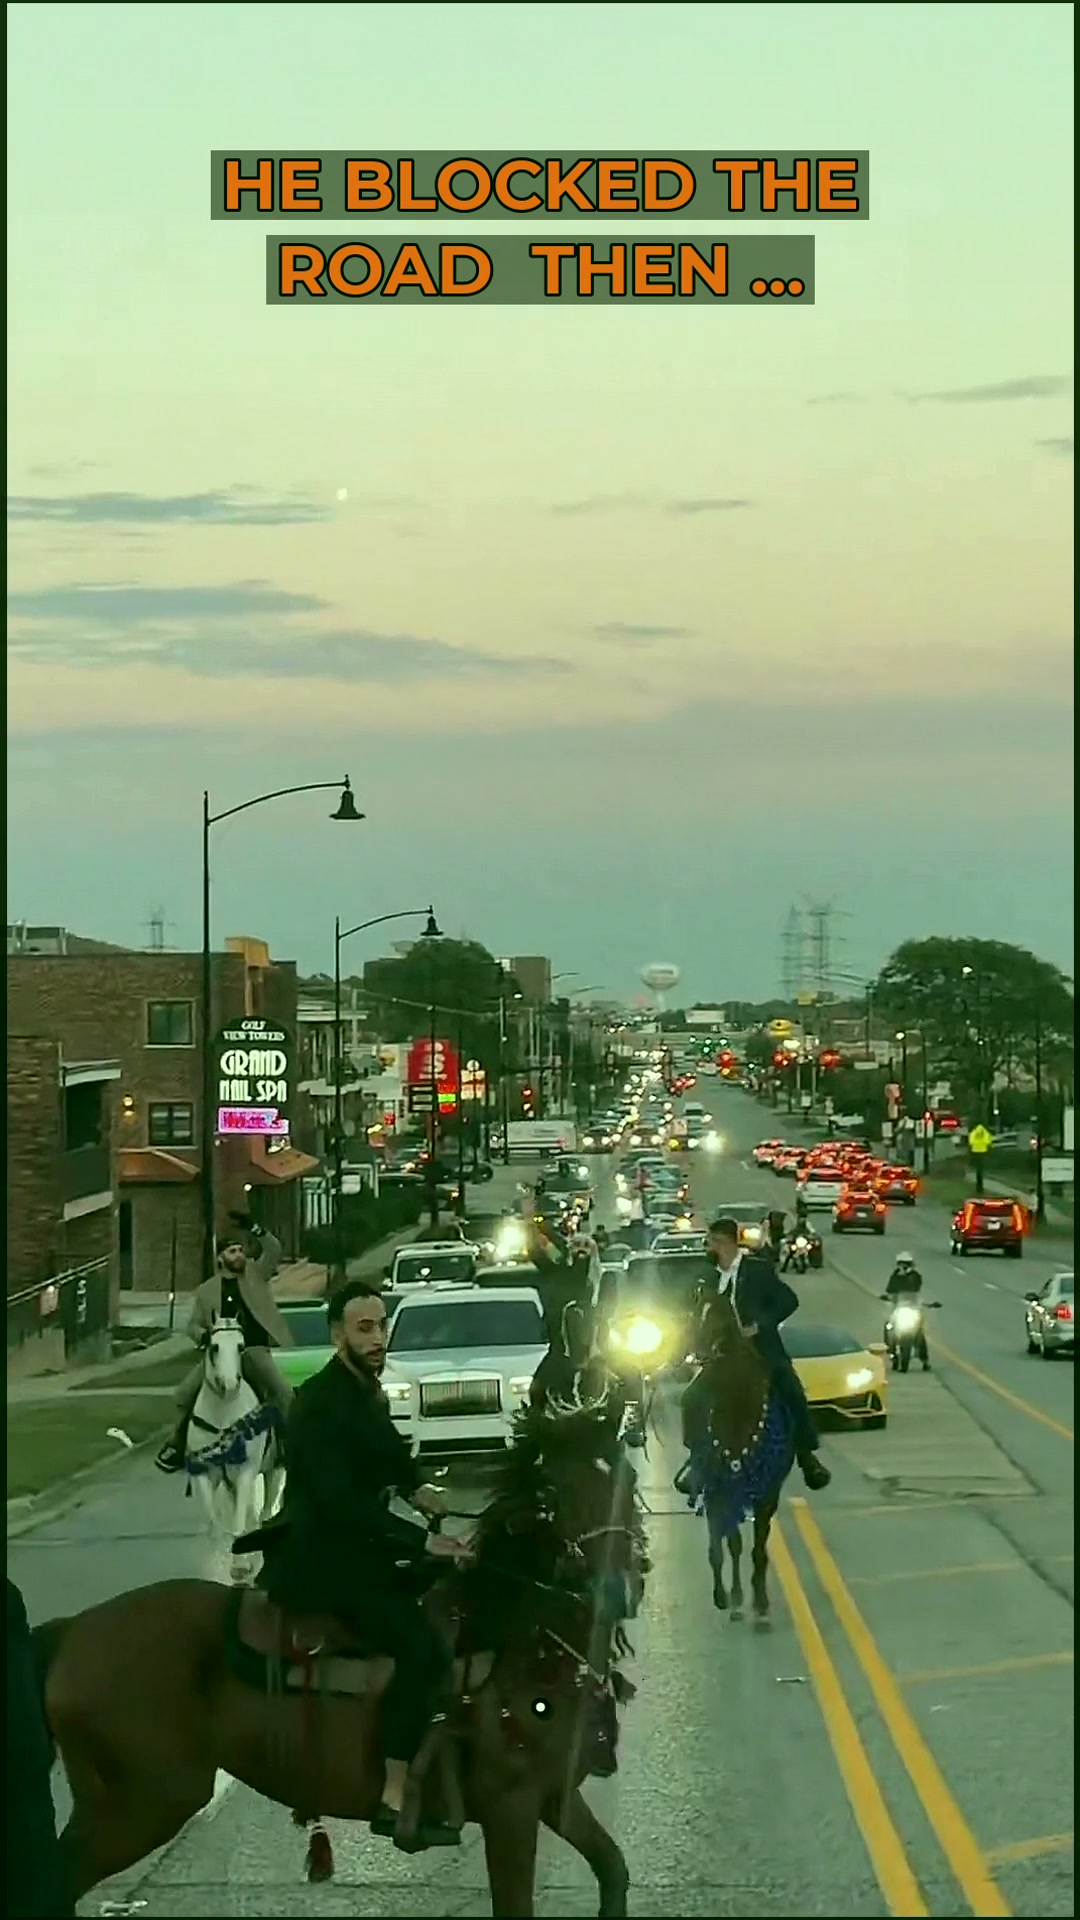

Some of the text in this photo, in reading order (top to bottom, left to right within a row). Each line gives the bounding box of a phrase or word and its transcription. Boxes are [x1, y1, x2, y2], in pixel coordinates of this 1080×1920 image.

[241, 1020, 266, 1030] GOLF
[223, 1030, 285, 1041] VIEW TOWERS
[220, 1049, 287, 1076] GRAND
[219, 1079, 288, 1102] NAIL SPA
